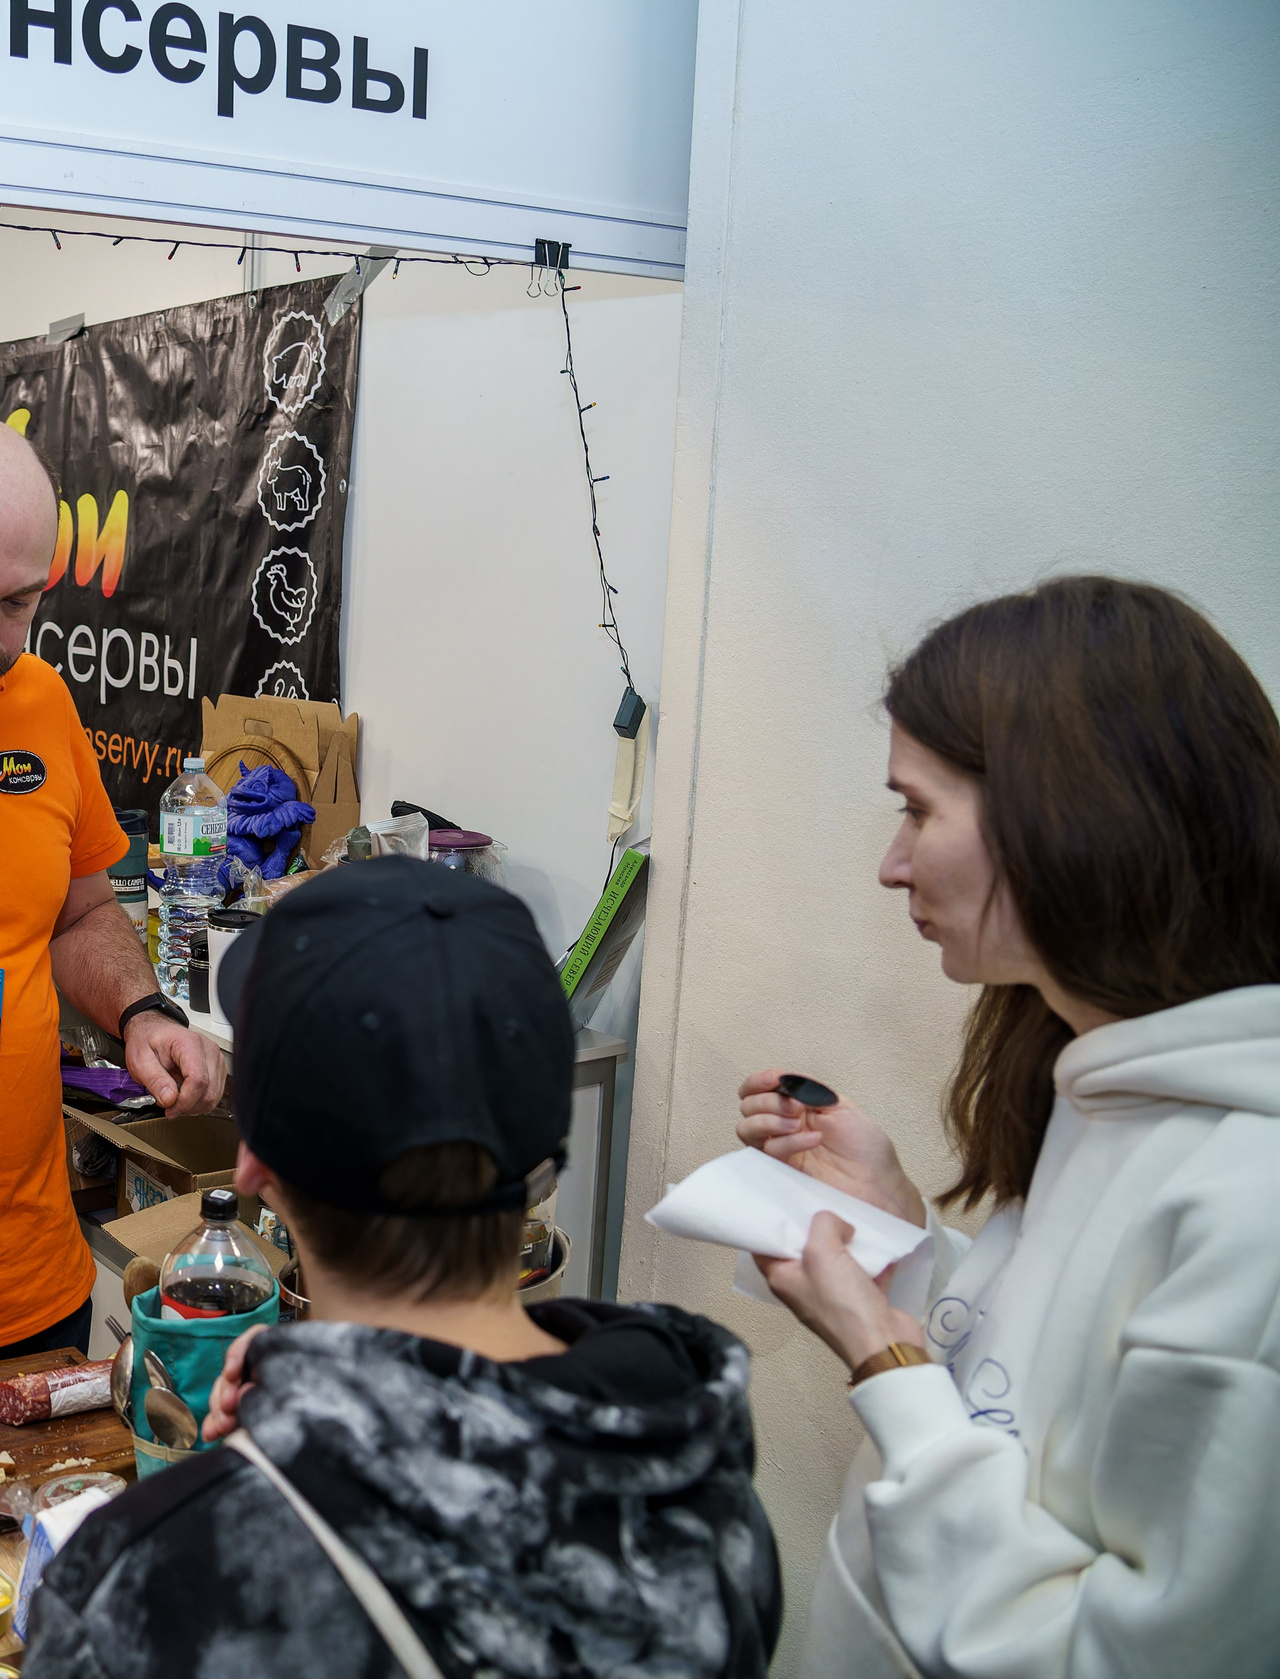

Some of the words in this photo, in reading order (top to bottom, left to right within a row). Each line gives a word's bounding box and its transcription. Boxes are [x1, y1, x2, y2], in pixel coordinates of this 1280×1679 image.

[8, 773, 43, 784] консервы
[579, 890, 619, 956] ИСЧЕЗАЮЩИЙ
[564, 957, 584, 987] СЕВЕР
